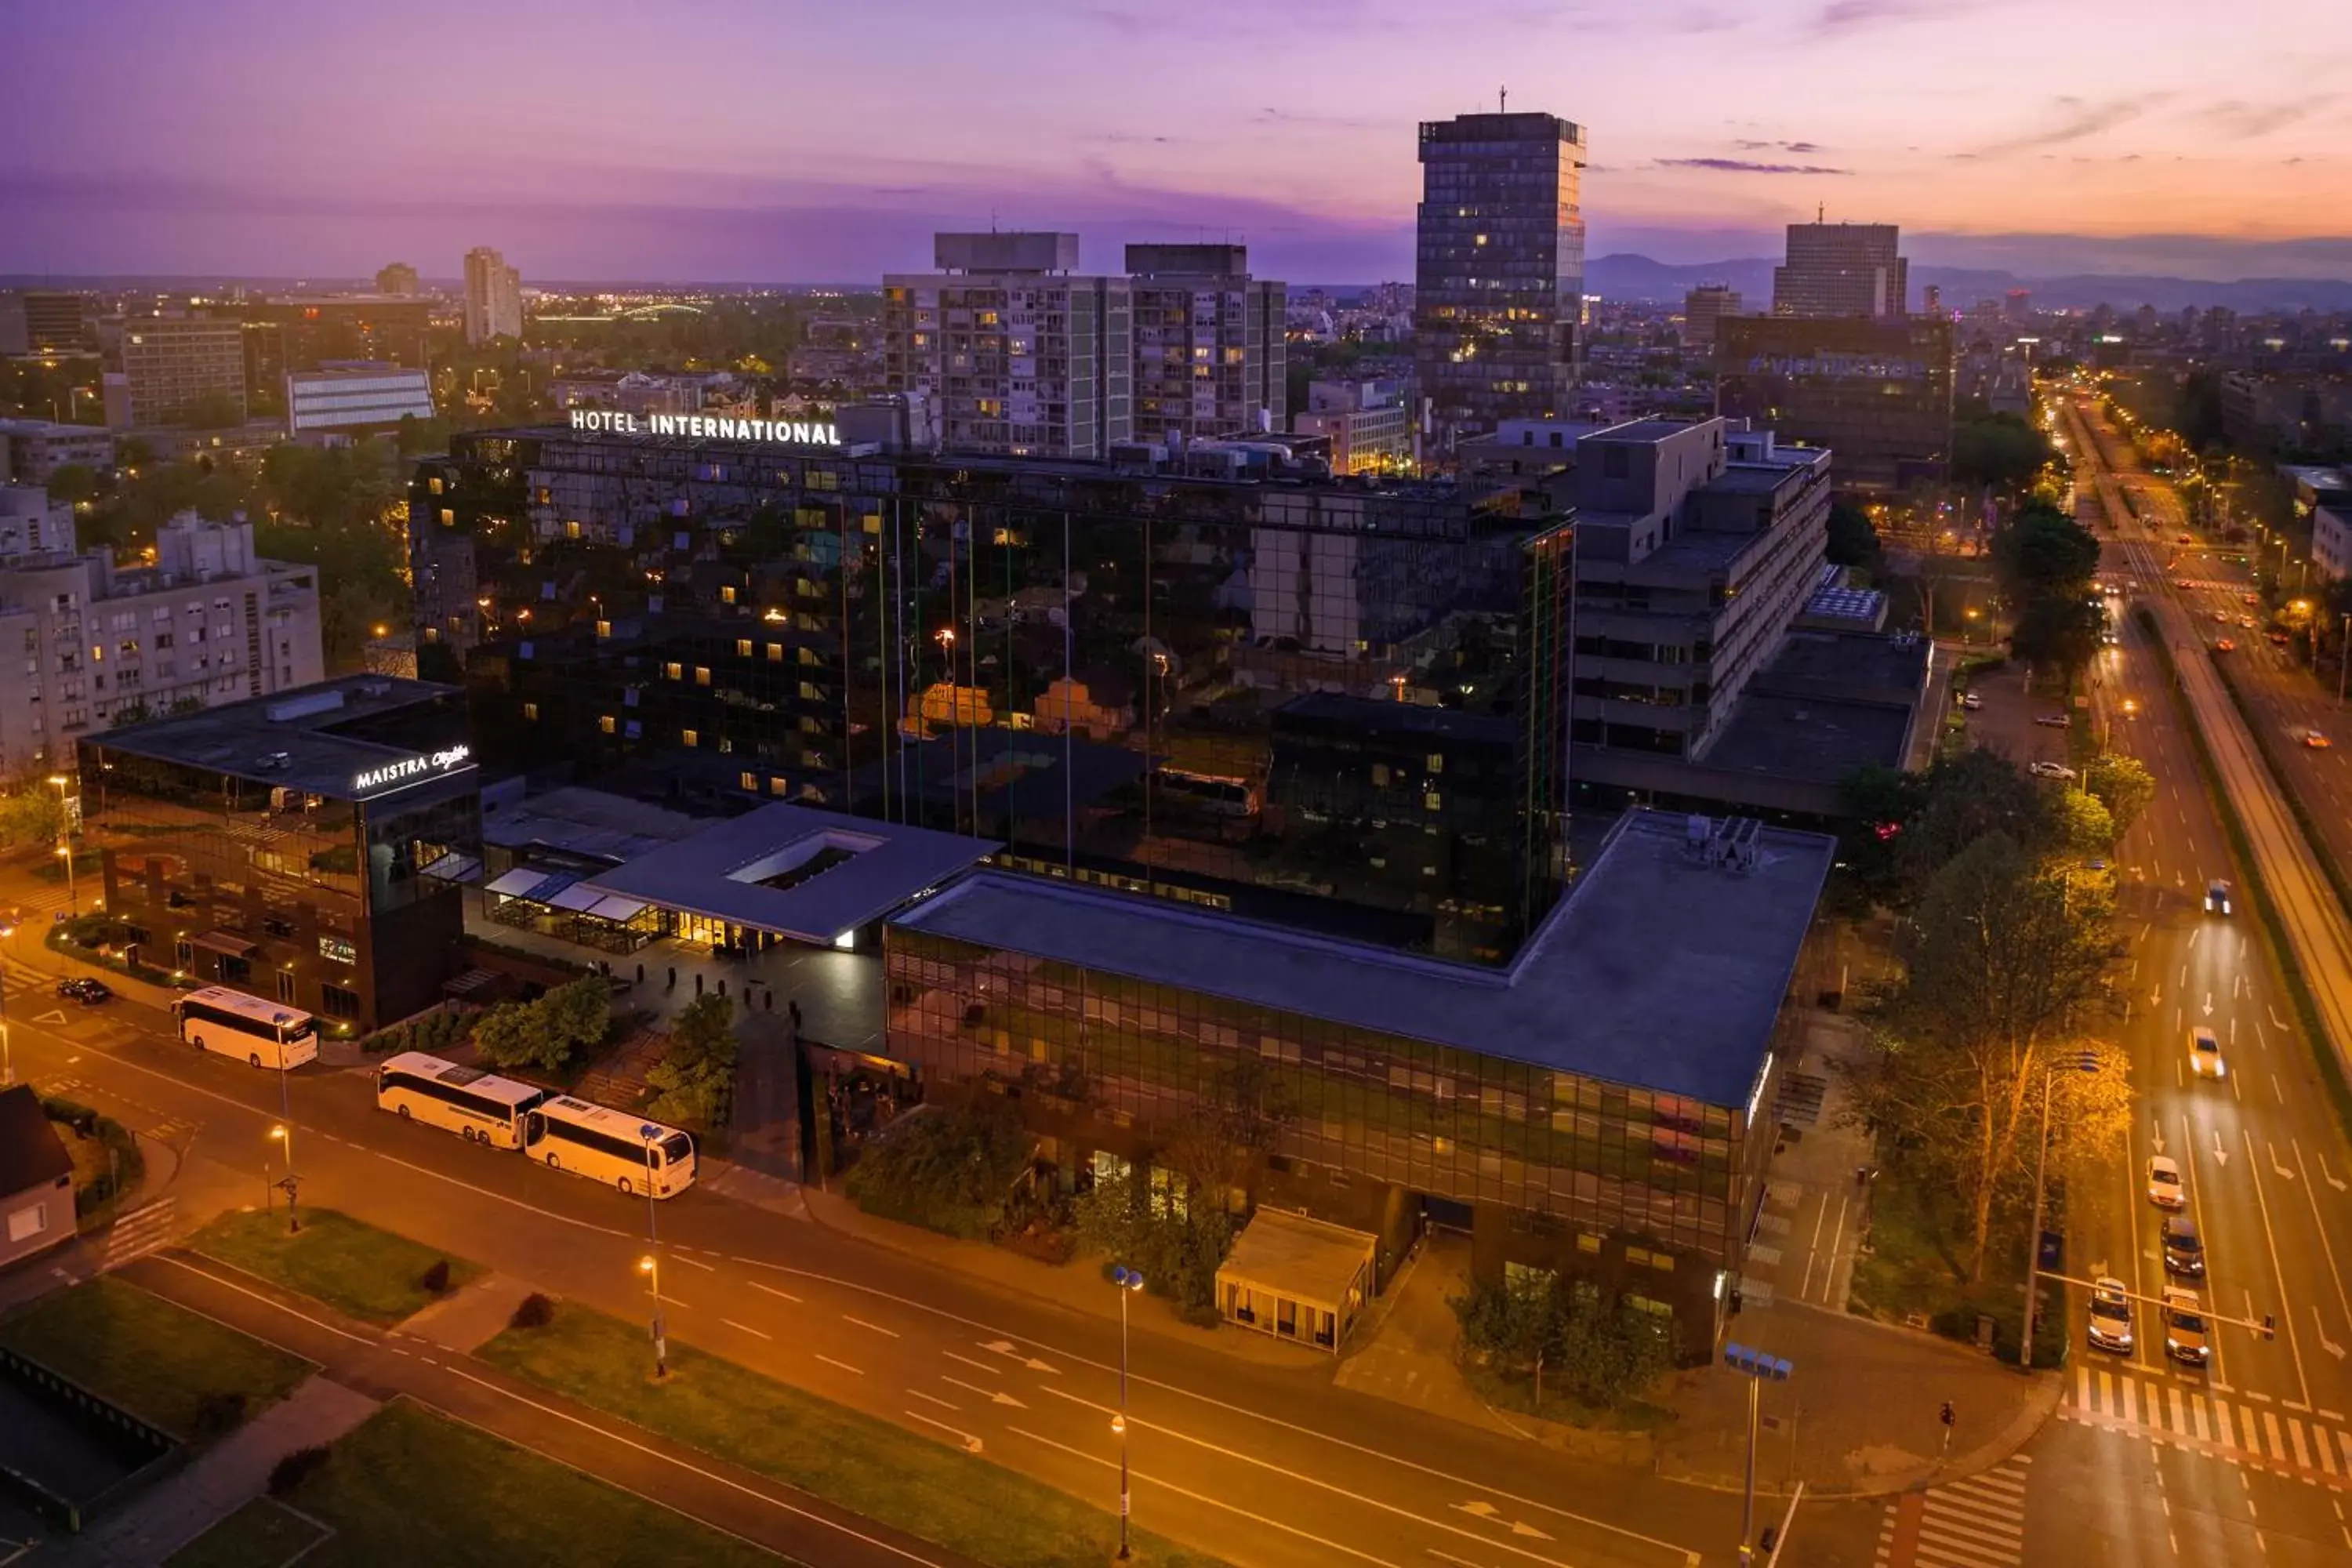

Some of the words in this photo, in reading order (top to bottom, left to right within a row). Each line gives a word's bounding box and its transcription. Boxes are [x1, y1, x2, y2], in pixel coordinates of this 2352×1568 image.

[572, 411, 637, 432] HOTEL
[651, 414, 841, 445] INTERNATIONAL
[357, 757, 427, 789] MAISTRA
